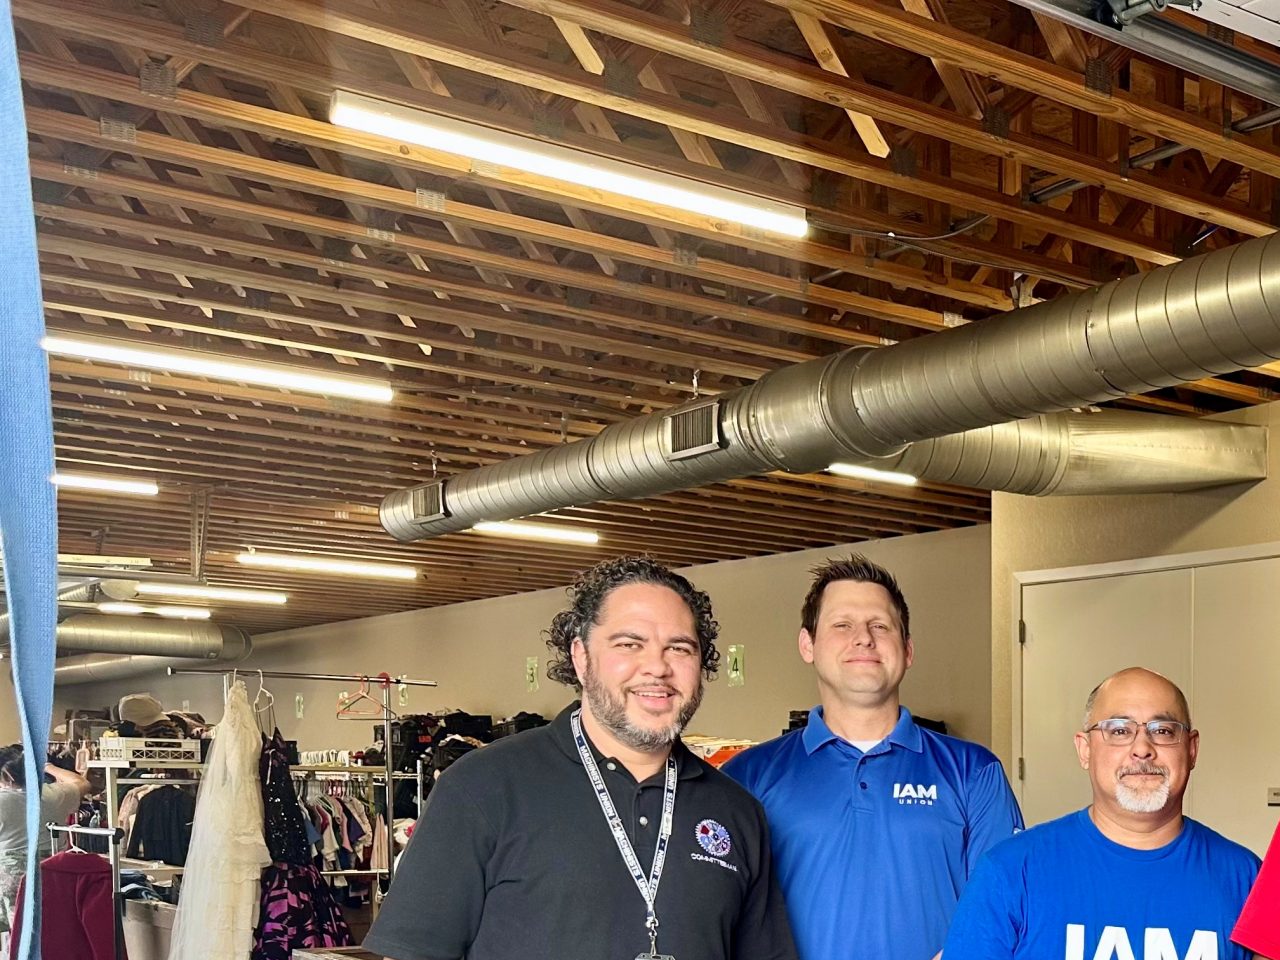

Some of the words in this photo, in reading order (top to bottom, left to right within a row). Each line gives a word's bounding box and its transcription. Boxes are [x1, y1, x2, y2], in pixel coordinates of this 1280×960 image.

[732, 657, 739, 673] 4
[579, 745, 604, 791] MACHINISTS
[598, 792, 615, 818] UNION
[667, 767, 676, 790] UNION
[893, 783, 938, 800] IAM
[653, 849, 665, 876] UNION
